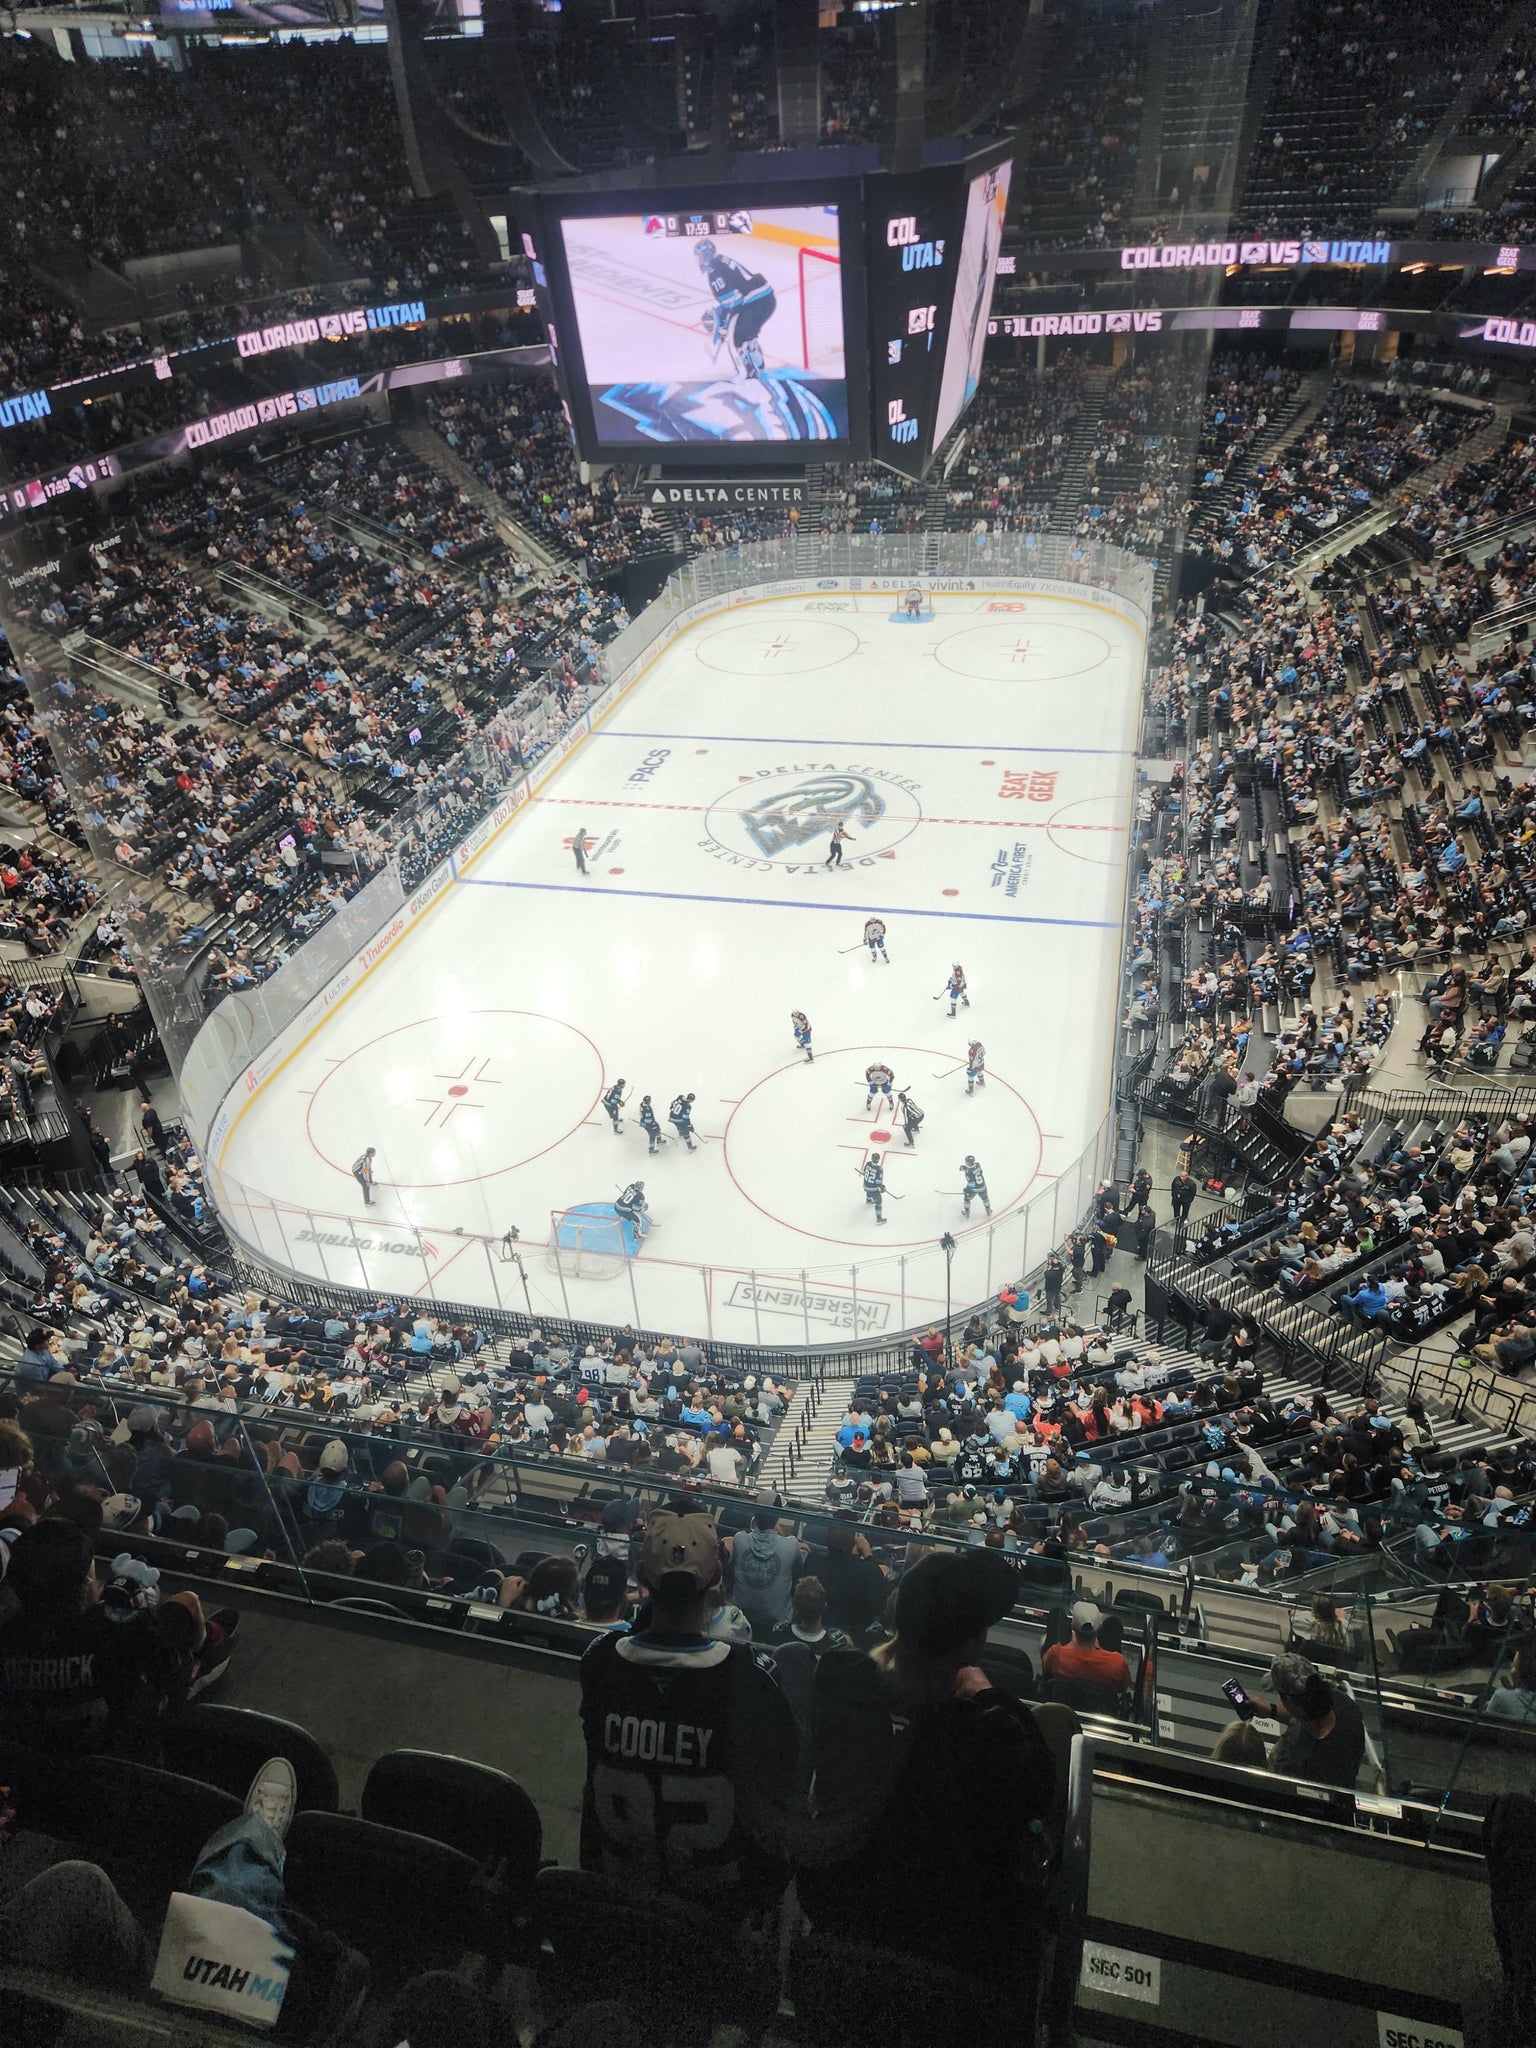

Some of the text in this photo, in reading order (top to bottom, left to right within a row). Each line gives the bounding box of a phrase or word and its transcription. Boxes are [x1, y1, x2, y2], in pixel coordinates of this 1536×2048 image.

[887, 216, 920, 247] COL
[1121, 241, 1390, 269] COLORADO VS UTAH
[236, 301, 427, 358] COLORADO VS UTAH
[1133, 311, 1163, 332] VS
[0, 389, 51, 429] UTAH
[185, 377, 361, 449] COLORADO VS UTAH
[669, 487, 802, 502] DELTA CENTER
[882, 580, 922, 589] DELTA
[981, 578, 1036, 591] HealthEquity
[628, 749, 671, 782] PACS
[755, 763, 921, 792] DELTA CENTER
[998, 770, 1029, 799] SEAT
[1027, 770, 1060, 802] GEEK
[697, 838, 876, 874] CENTER DETA
[1004, 841, 1027, 898] AMERICA FIRST
[328, 975, 351, 1001] ULTRA
[863, 1169, 877, 1184] 82
[741, 1286, 879, 1319] INGREDIENTS
[829, 1314, 878, 1332] JUST
[585, 1368, 600, 1382] 98
[604, 1712, 714, 1768] COOLEY
[183, 1955, 251, 1993] UTAH
[1089, 1956, 1153, 1987] SEC 501
[1385, 2028, 1418, 2048] SEC
